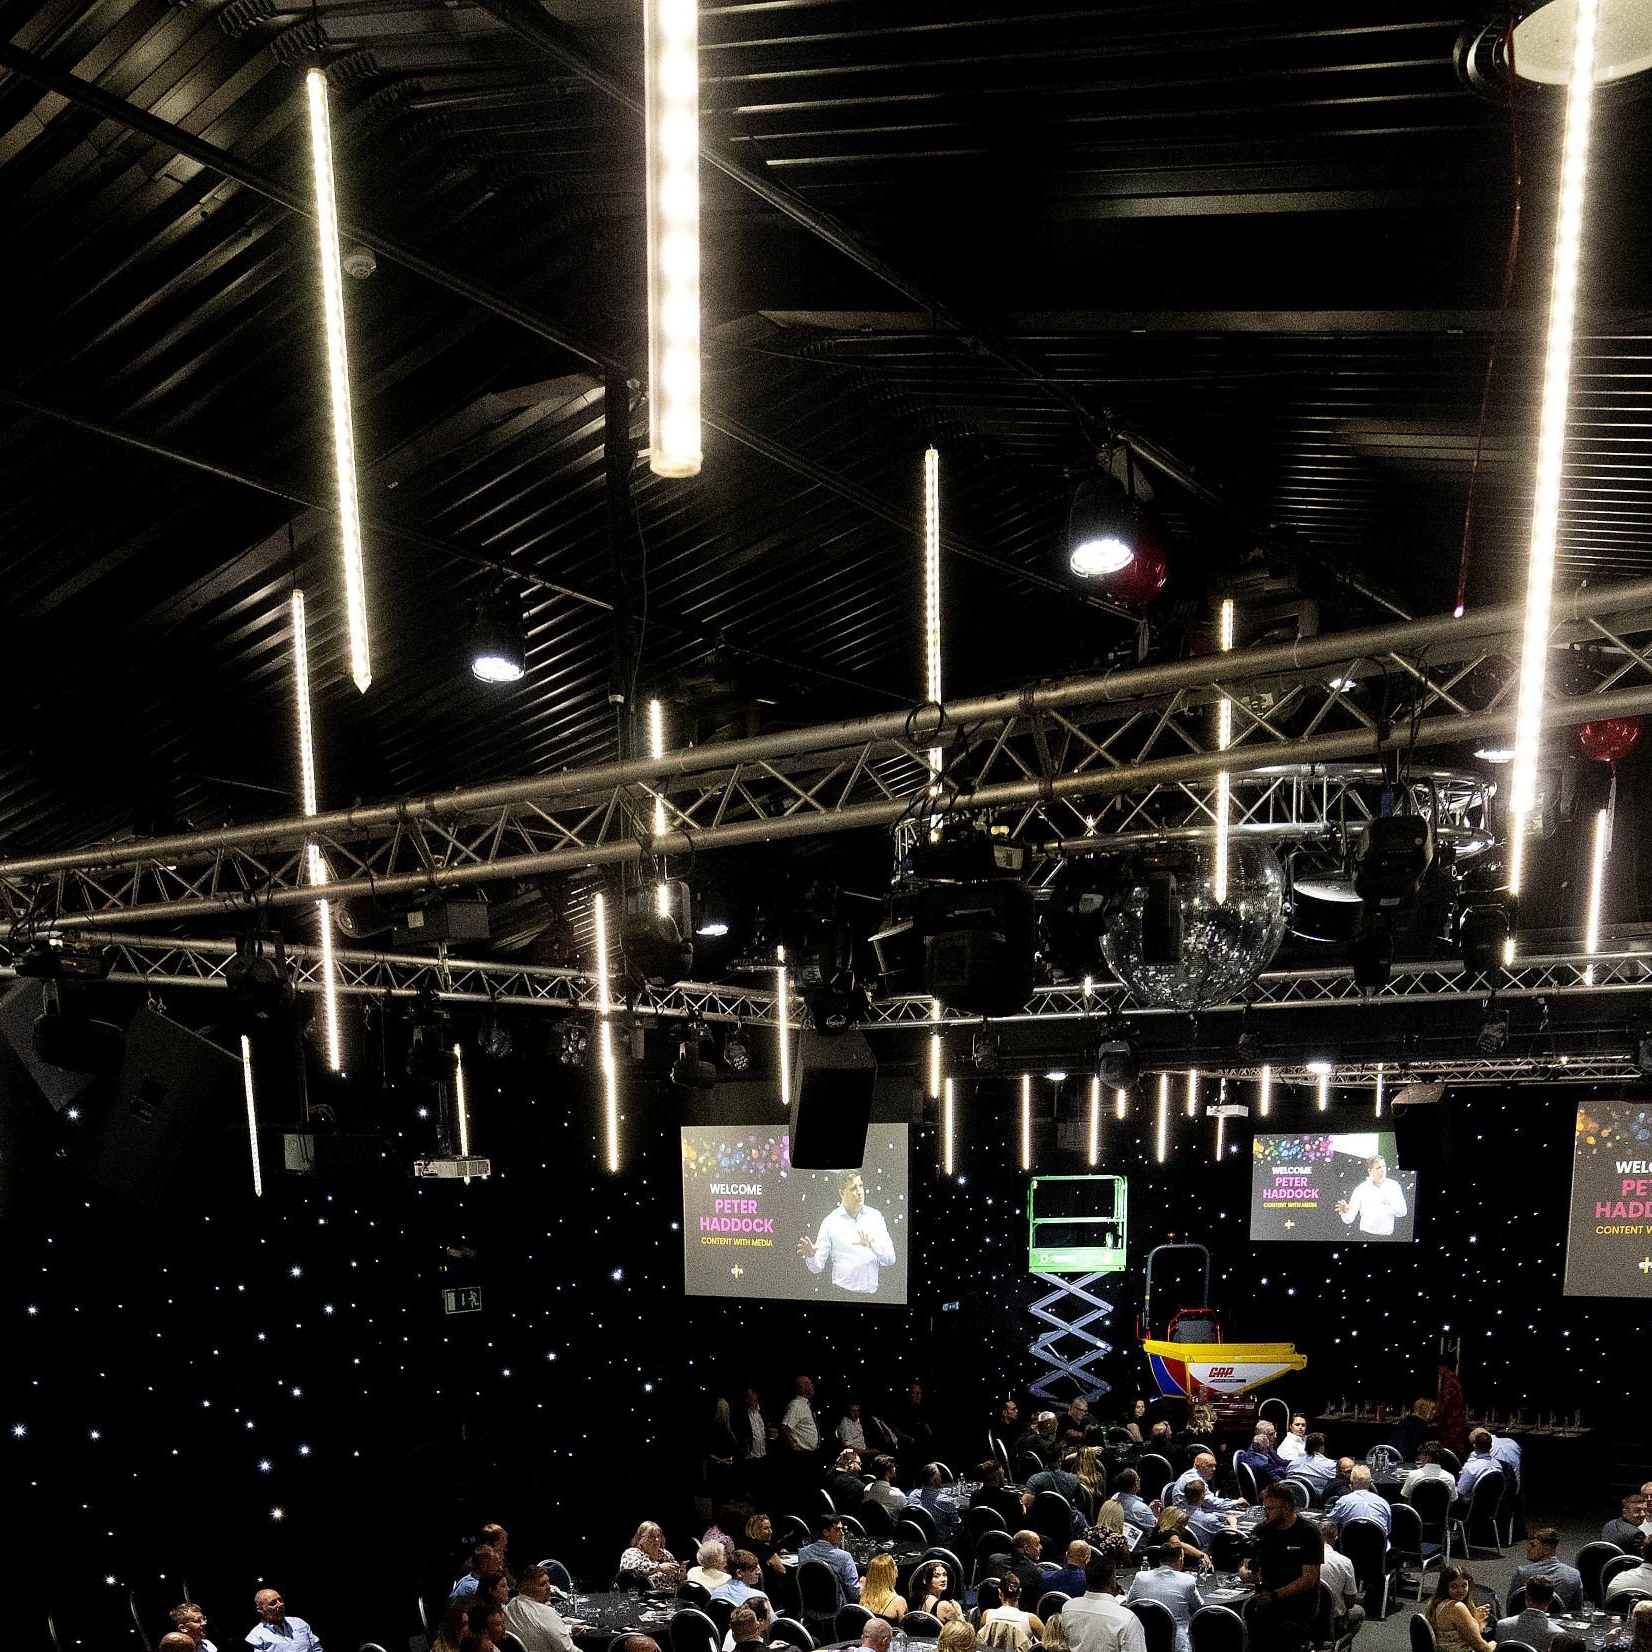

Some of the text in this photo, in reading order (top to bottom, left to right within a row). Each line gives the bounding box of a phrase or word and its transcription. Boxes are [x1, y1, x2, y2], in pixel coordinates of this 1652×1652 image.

[1275, 1177, 1308, 1187] PETER
[710, 1183, 763, 1195] WELCOME
[1263, 1188, 1319, 1198] HADDOCK
[715, 1199, 758, 1214] PETER
[699, 1216, 774, 1233] HADDOCK
[1595, 1225, 1644, 1235] CONTENT
[701, 1237, 773, 1247] CONTENT WITH MEDIA
